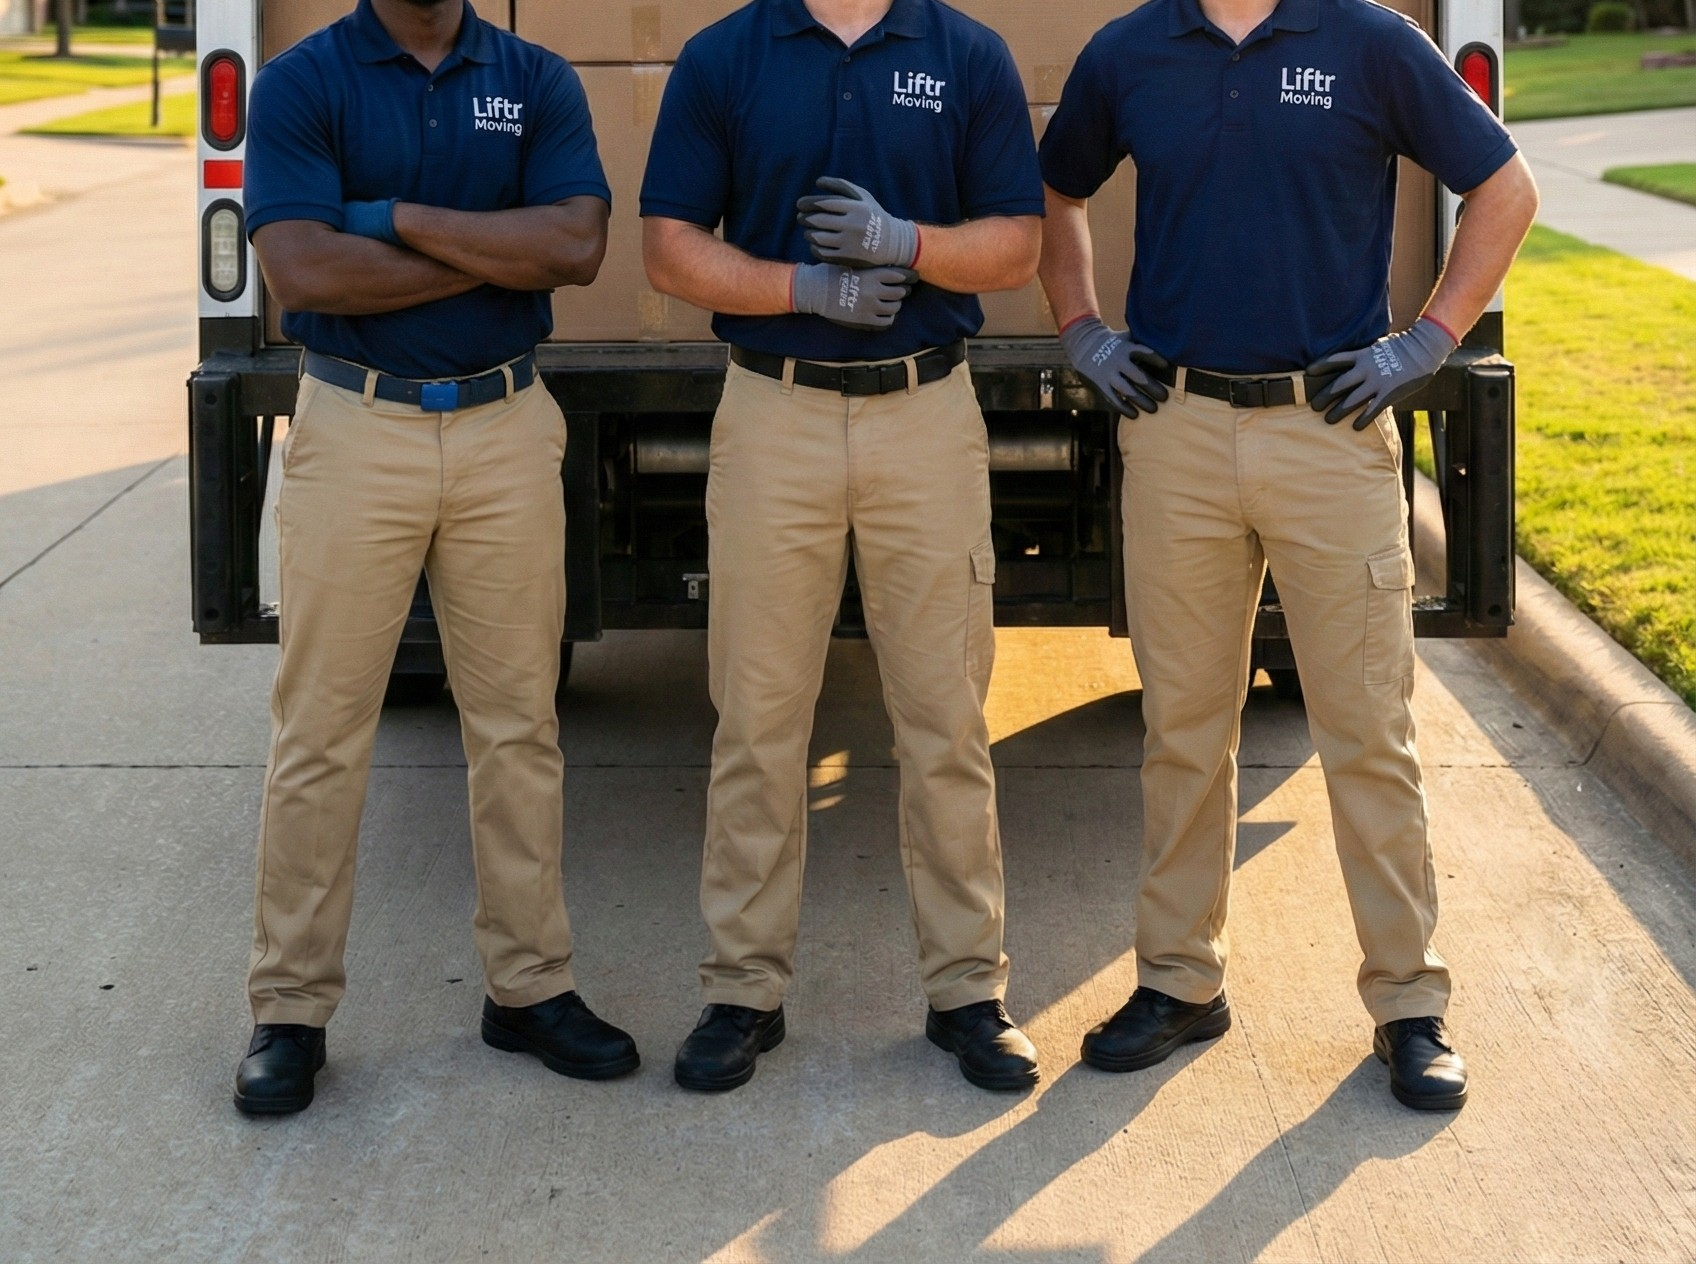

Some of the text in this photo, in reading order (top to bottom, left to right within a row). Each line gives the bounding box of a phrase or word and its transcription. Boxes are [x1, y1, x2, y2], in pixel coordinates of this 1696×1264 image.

[893, 71, 946, 96] Liftr
[1281, 67, 1336, 92] Liftr
[473, 97, 523, 119] Liftr
[892, 93, 942, 113] Moving
[1280, 91, 1332, 109] Moving
[475, 118, 522, 137] Moving
